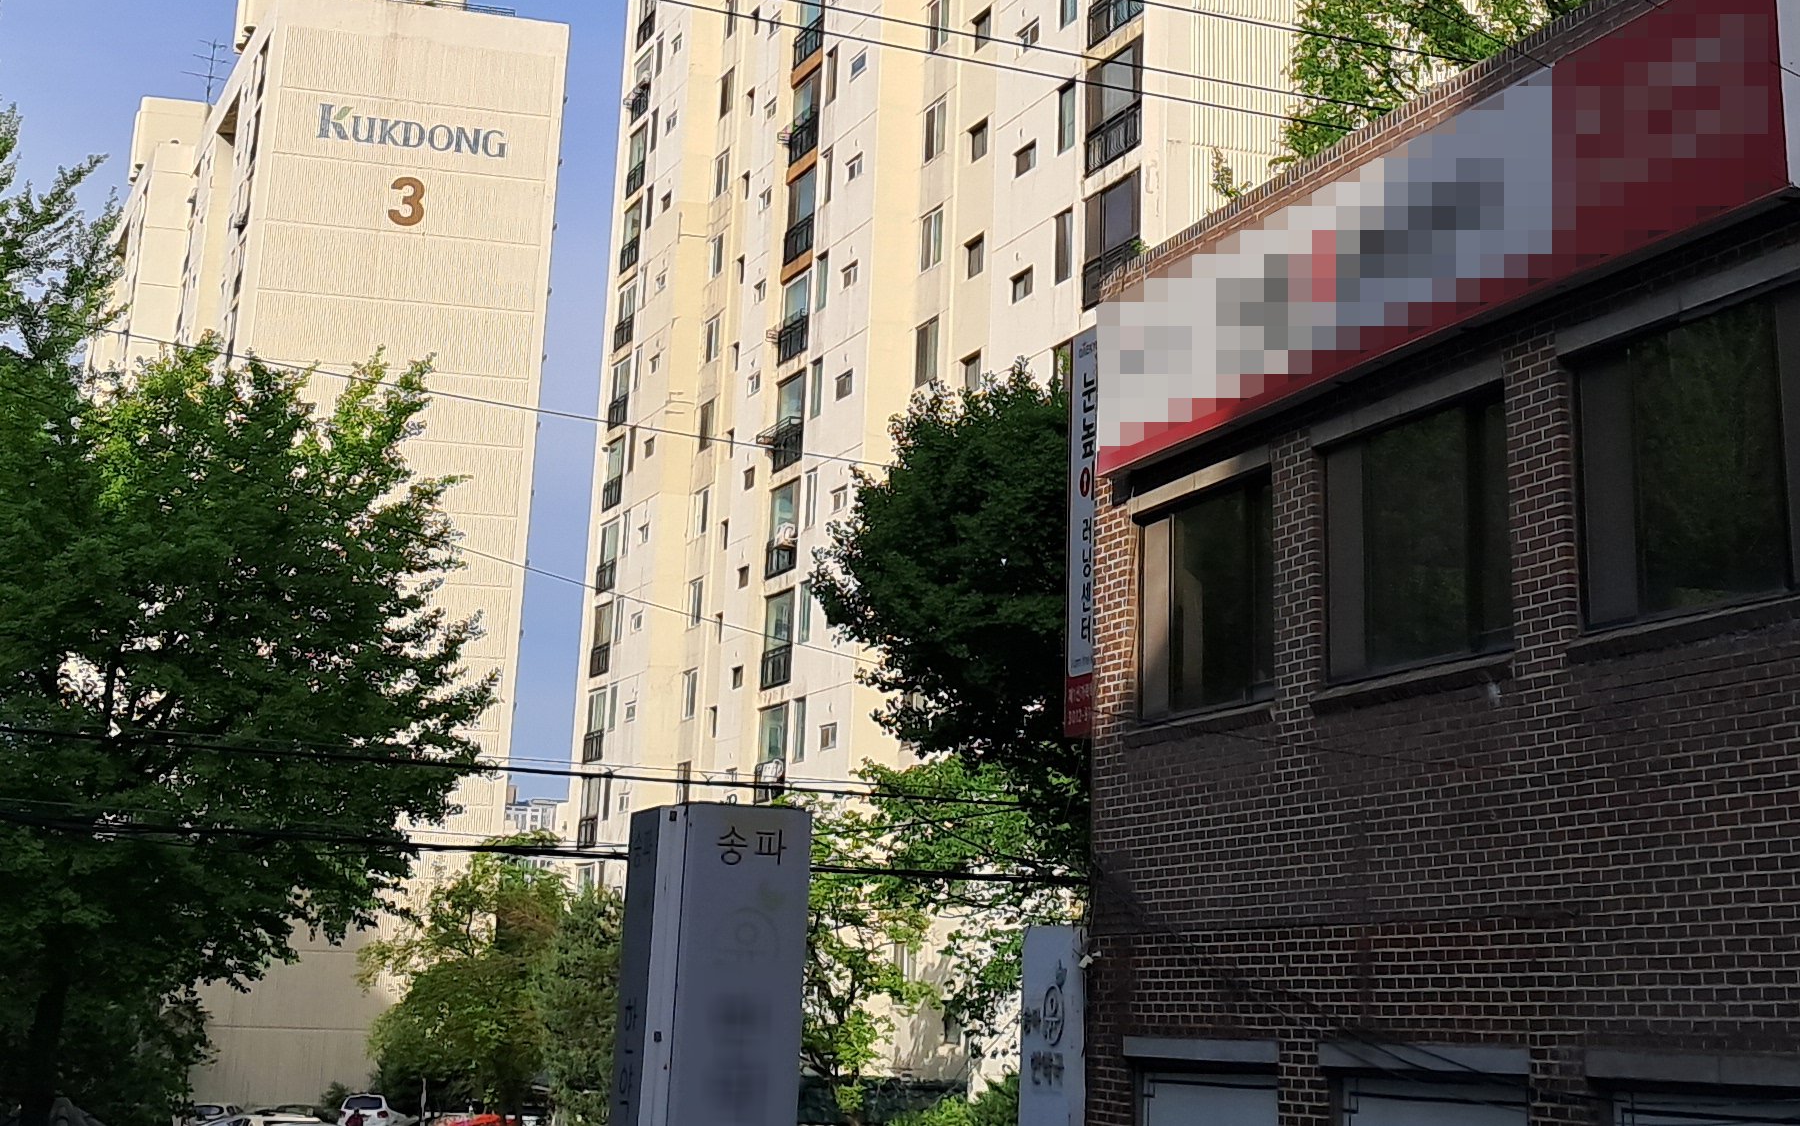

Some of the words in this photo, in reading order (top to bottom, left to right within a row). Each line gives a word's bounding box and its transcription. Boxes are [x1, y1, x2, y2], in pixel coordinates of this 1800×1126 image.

[388, 176, 425, 227] 3
[1080, 372, 1097, 501] 눈높이
[1080, 516, 1092, 643] 러닝센터
[717, 826, 787, 866] 송파
